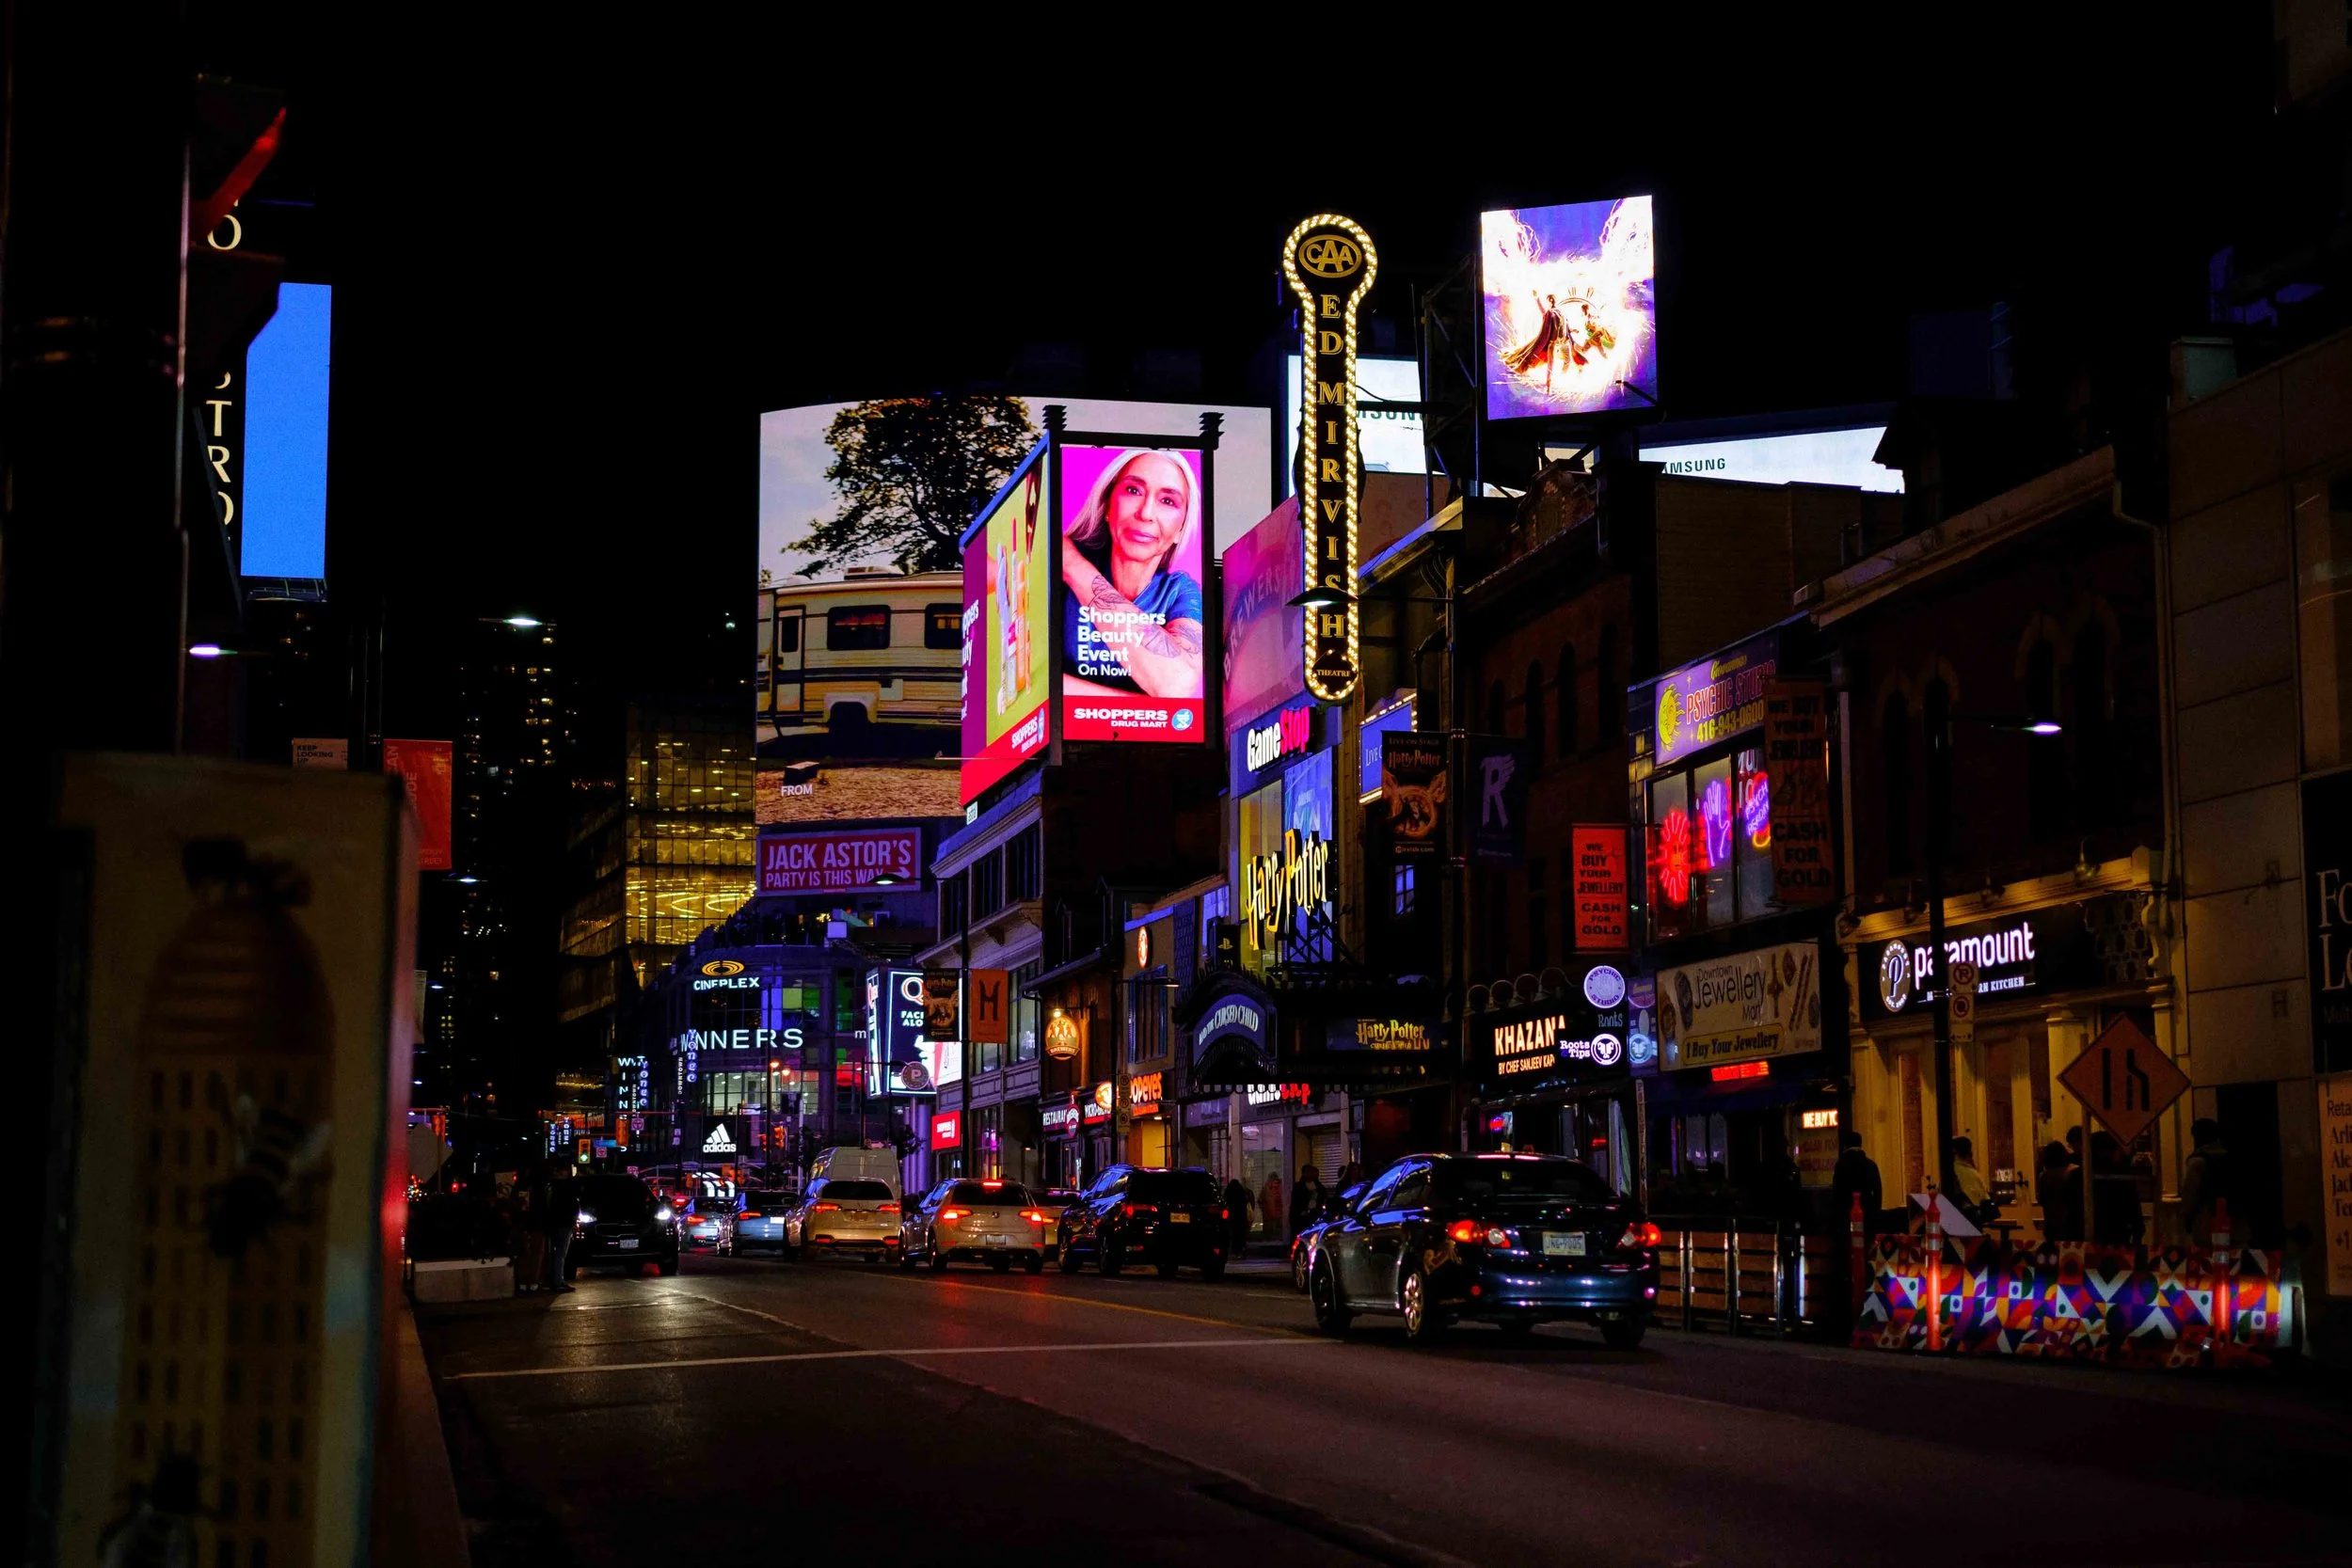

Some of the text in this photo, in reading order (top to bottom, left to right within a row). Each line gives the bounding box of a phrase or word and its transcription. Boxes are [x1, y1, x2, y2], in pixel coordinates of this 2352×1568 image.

[1305, 240, 1355, 273] CAA
[1317, 293, 1348, 639] ED MIRVISH
[1078, 606, 1166, 626] Shoppers
[1078, 626, 1144, 645] Beauty
[1078, 646, 1129, 662] Event
[1078, 664, 1132, 676] On Now!
[1317, 669, 1351, 678] THEATRE
[1686, 676, 1734, 725] PSYCHIC
[1073, 708, 1168, 721] SHOPPERS
[1247, 705, 1311, 772] GameStop
[780, 784, 814, 798] FROM
[1772, 822, 1828, 842] CASH
[765, 838, 913, 870] JACK ASTOR'S
[1581, 854, 1608, 866] BUY
[1784, 848, 1820, 863] FOR
[765, 870, 805, 889] PARTY
[809, 871, 821, 887] IS
[824, 869, 852, 887] THIS
[1776, 868, 1833, 888] GOLD
[1245, 828, 1328, 951] Harry Potter
[1581, 903, 1621, 912] CASH
[1581, 925, 1622, 935] GOLD
[1914, 921, 2036, 990] paamount
[692, 975, 761, 992] CINEPLEX
[1588, 967, 1621, 982] PSYCHIC
[1990, 976, 2025, 991] KITCHEN
[1694, 966, 1767, 1010] Jewellery
[978, 979, 1001, 1022] H
[1591, 993, 1620, 1006] STUDIO
[1237, 1004, 1259, 1033] CHILD
[1742, 1004, 1762, 1022] Mart
[680, 1027, 804, 1053] WNNERS
[1355, 1022, 1391, 1045] Harry
[1390, 1019, 1425, 1045] Potter
[1559, 1039, 1591, 1050] Roots
[1692, 1041, 1709, 1059] Buy
[1711, 1037, 1733, 1055] Your
[1734, 1031, 1779, 1052] Jewellery
[1568, 1049, 1591, 1060] Tips
[911, 1069, 922, 1080] P
[1498, 1061, 1506, 1075] BY
[1506, 1059, 1519, 1074] CHEF
[1519, 1056, 1543, 1071] SANJEEV
[702, 1141, 737, 1153] adidas
